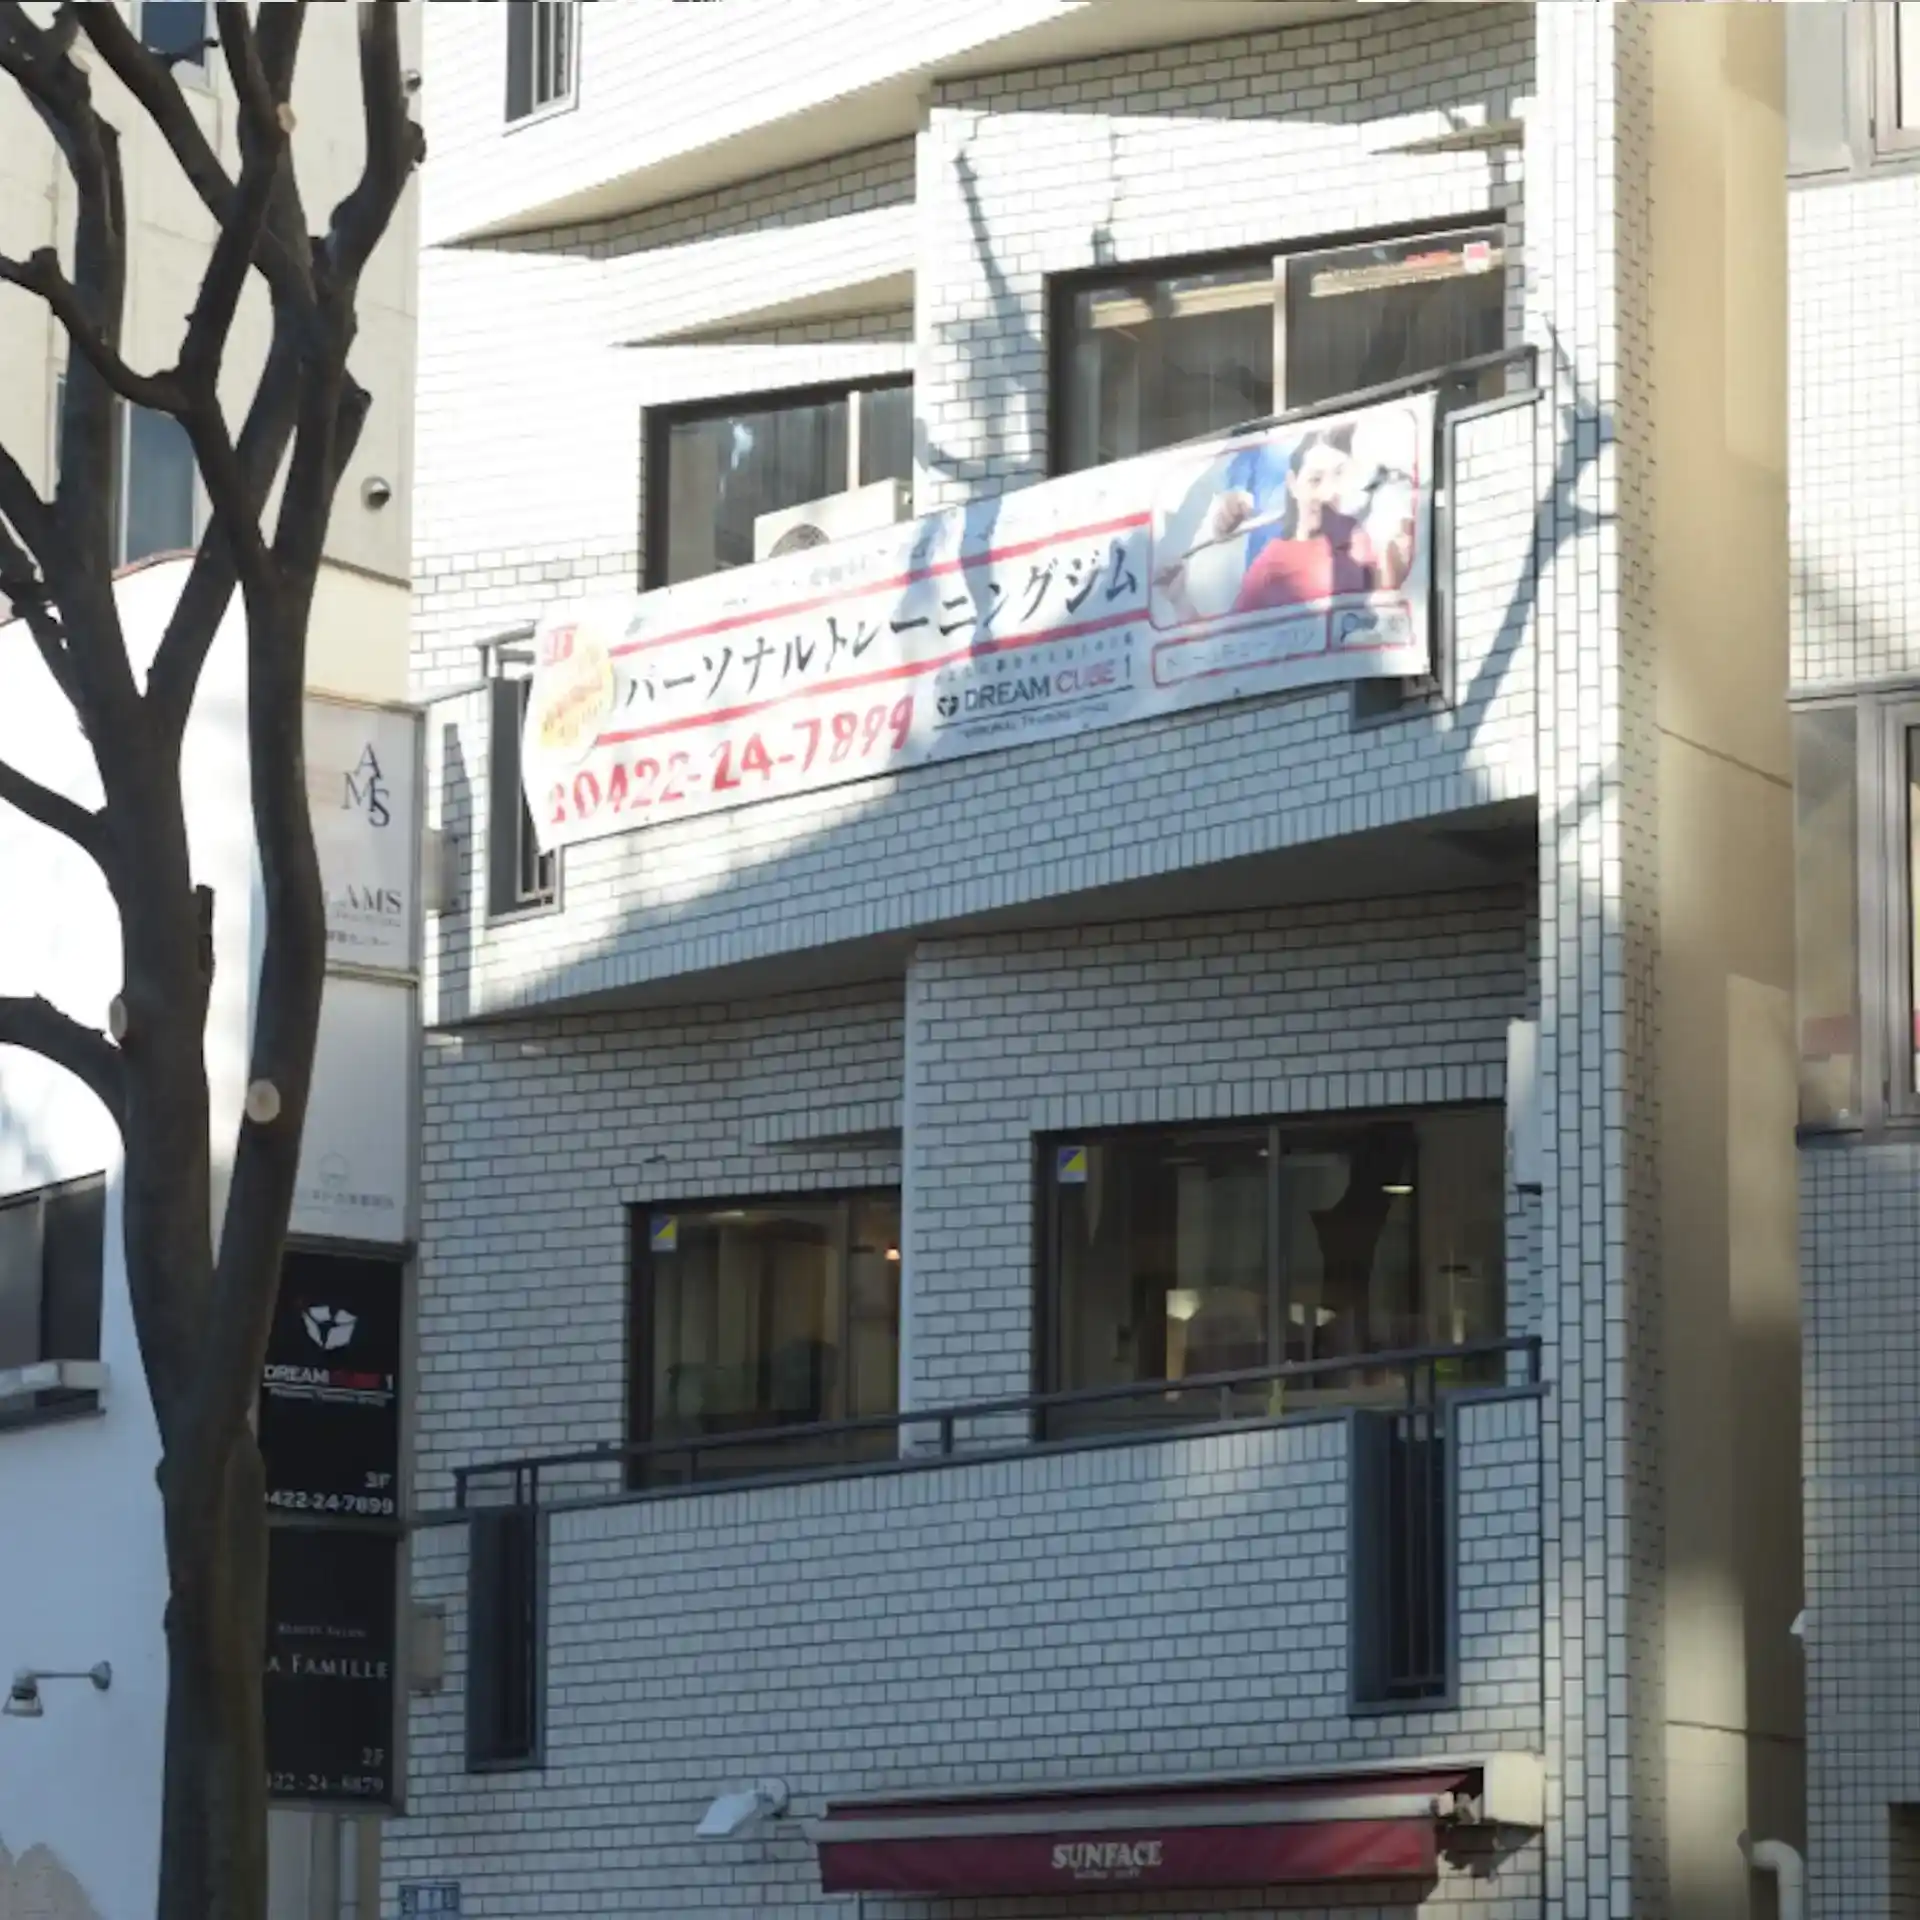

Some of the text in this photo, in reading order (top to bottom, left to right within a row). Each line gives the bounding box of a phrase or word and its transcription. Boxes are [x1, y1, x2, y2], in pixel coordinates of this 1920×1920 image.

[626, 548, 1137, 706] パーソナルトレーニングジム
[963, 668, 1051, 711] DREAM
[1051, 1840, 1163, 1869] SUNFACE
